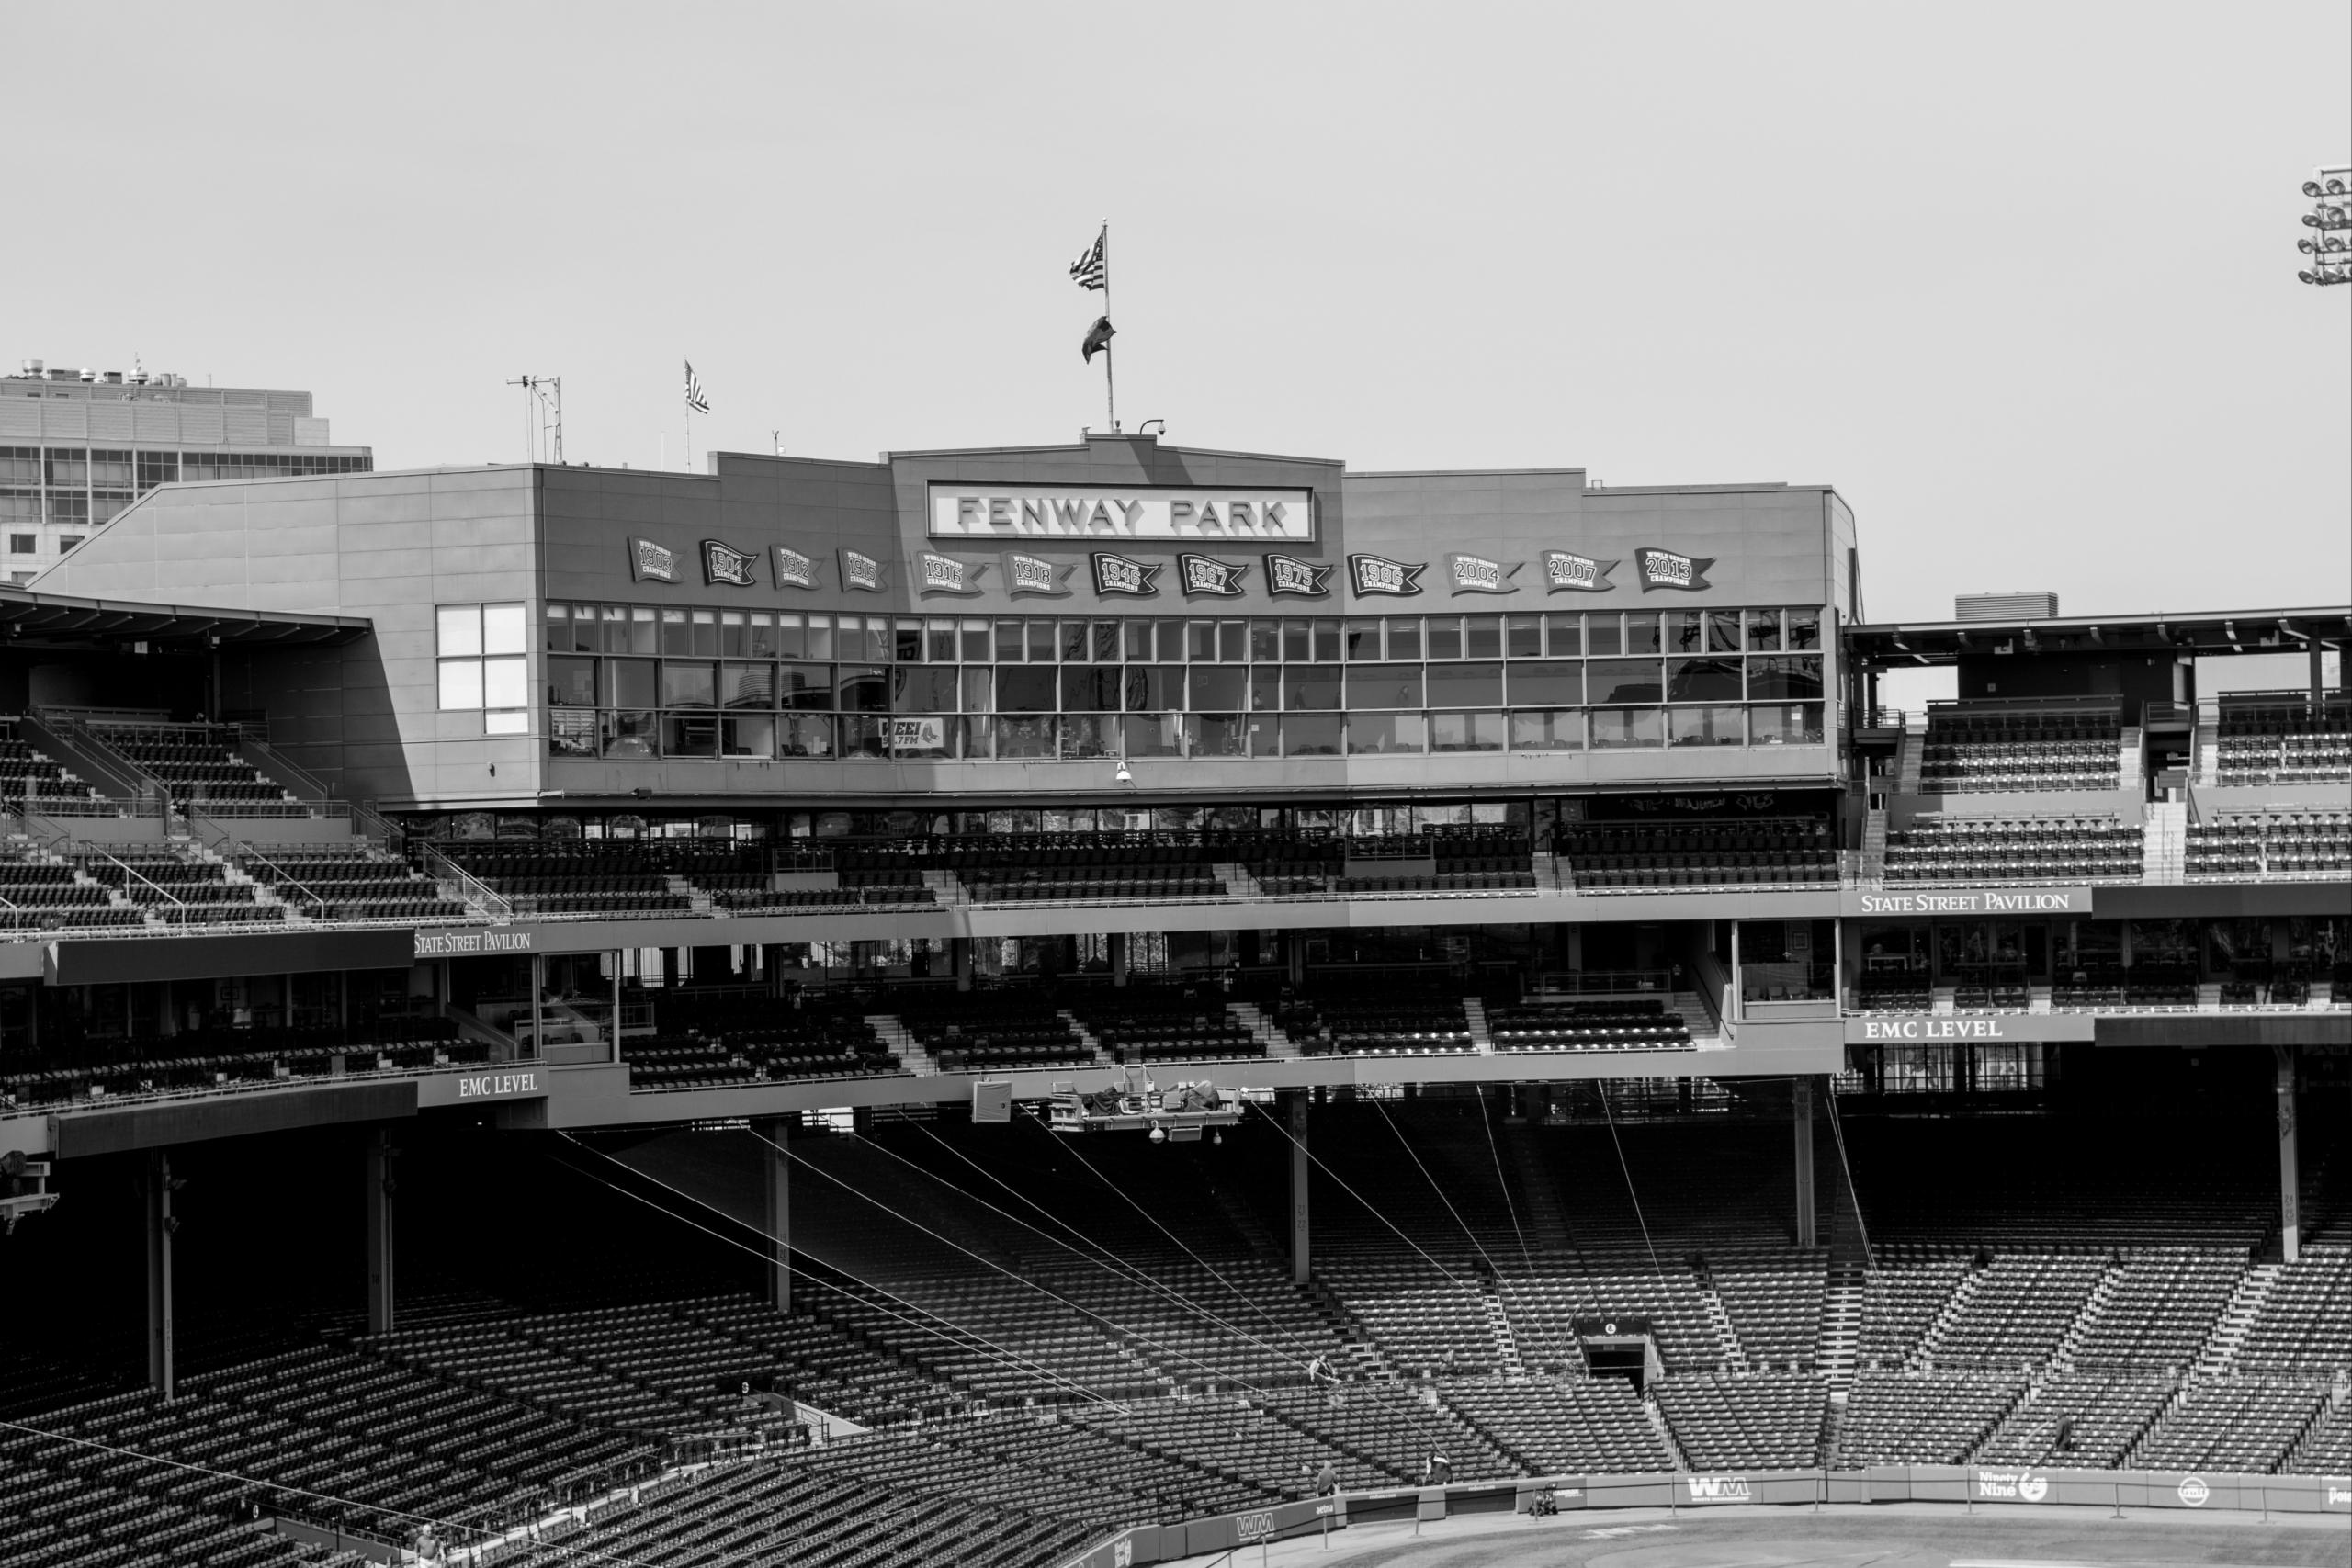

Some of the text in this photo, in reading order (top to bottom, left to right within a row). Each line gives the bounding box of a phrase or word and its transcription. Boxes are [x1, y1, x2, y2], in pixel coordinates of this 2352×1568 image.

[957, 496, 1283, 528] FENWAY PARK
[639, 547, 673, 572] 1903
[711, 551, 742, 576] 1904
[923, 554, 963, 569] WORLD SERIES
[1033, 559, 1052, 570] SERIES
[1102, 558, 1124, 566] AMERICAN
[1189, 558, 1210, 567] AMERICAN
[1275, 558, 1295, 567] AMERICAN
[1456, 556, 1498, 569] WORLD SERIES
[1551, 553, 1594, 566] WORLD SERIES
[1646, 551, 1690, 564] WORLD SERIES
[643, 566, 671, 579] CHAMPIONS
[782, 555, 809, 579] 1912
[849, 558, 876, 581] 1915
[925, 560, 963, 583] 1916
[1015, 562, 1051, 583] 1918
[1384, 562, 1401, 571] LEAGUE
[1454, 563, 1499, 583] 2004
[1549, 560, 1597, 581] 2007
[1645, 558, 1692, 580] 2013
[714, 570, 741, 582] CHAMPIONS
[783, 573, 808, 585] CHAMPIONS
[1102, 562, 1141, 586] 1946
[1188, 563, 1227, 586] 1967
[1274, 564, 1313, 586] 1975
[1360, 564, 1403, 586] 1986
[1650, 575, 1690, 586] CHAMPIONS
[850, 575, 876, 588] CHAMPIONS
[927, 578, 962, 590] CHAMPIONS
[1016, 579, 1051, 591] CHAMPIONS
[1104, 580, 1138, 592] CHAMPIONS
[1192, 581, 1226, 592] CHAMPIONS
[1278, 581, 1310, 592] CHAMPIONS
[1363, 581, 1401, 592] CHAMPIONS
[1460, 578, 1497, 589] CHAMPIONS
[1555, 577, 1593, 588] CHAMPIONS
[1861, 892, 2069, 912] STATE STREET PAVILION
[414, 931, 531, 953] STATE STREET PAVILION
[1865, 1021, 2003, 1038] EMC LEVEL
[459, 1073, 537, 1098] EMC LEVEL
[1979, 1472, 2018, 1486] Ninety
[1688, 1477, 1749, 1496] WM
[1979, 1482, 2017, 1497] Nine
[1316, 1505, 1333, 1515] aetna
[1237, 1513, 1274, 1537] WM
